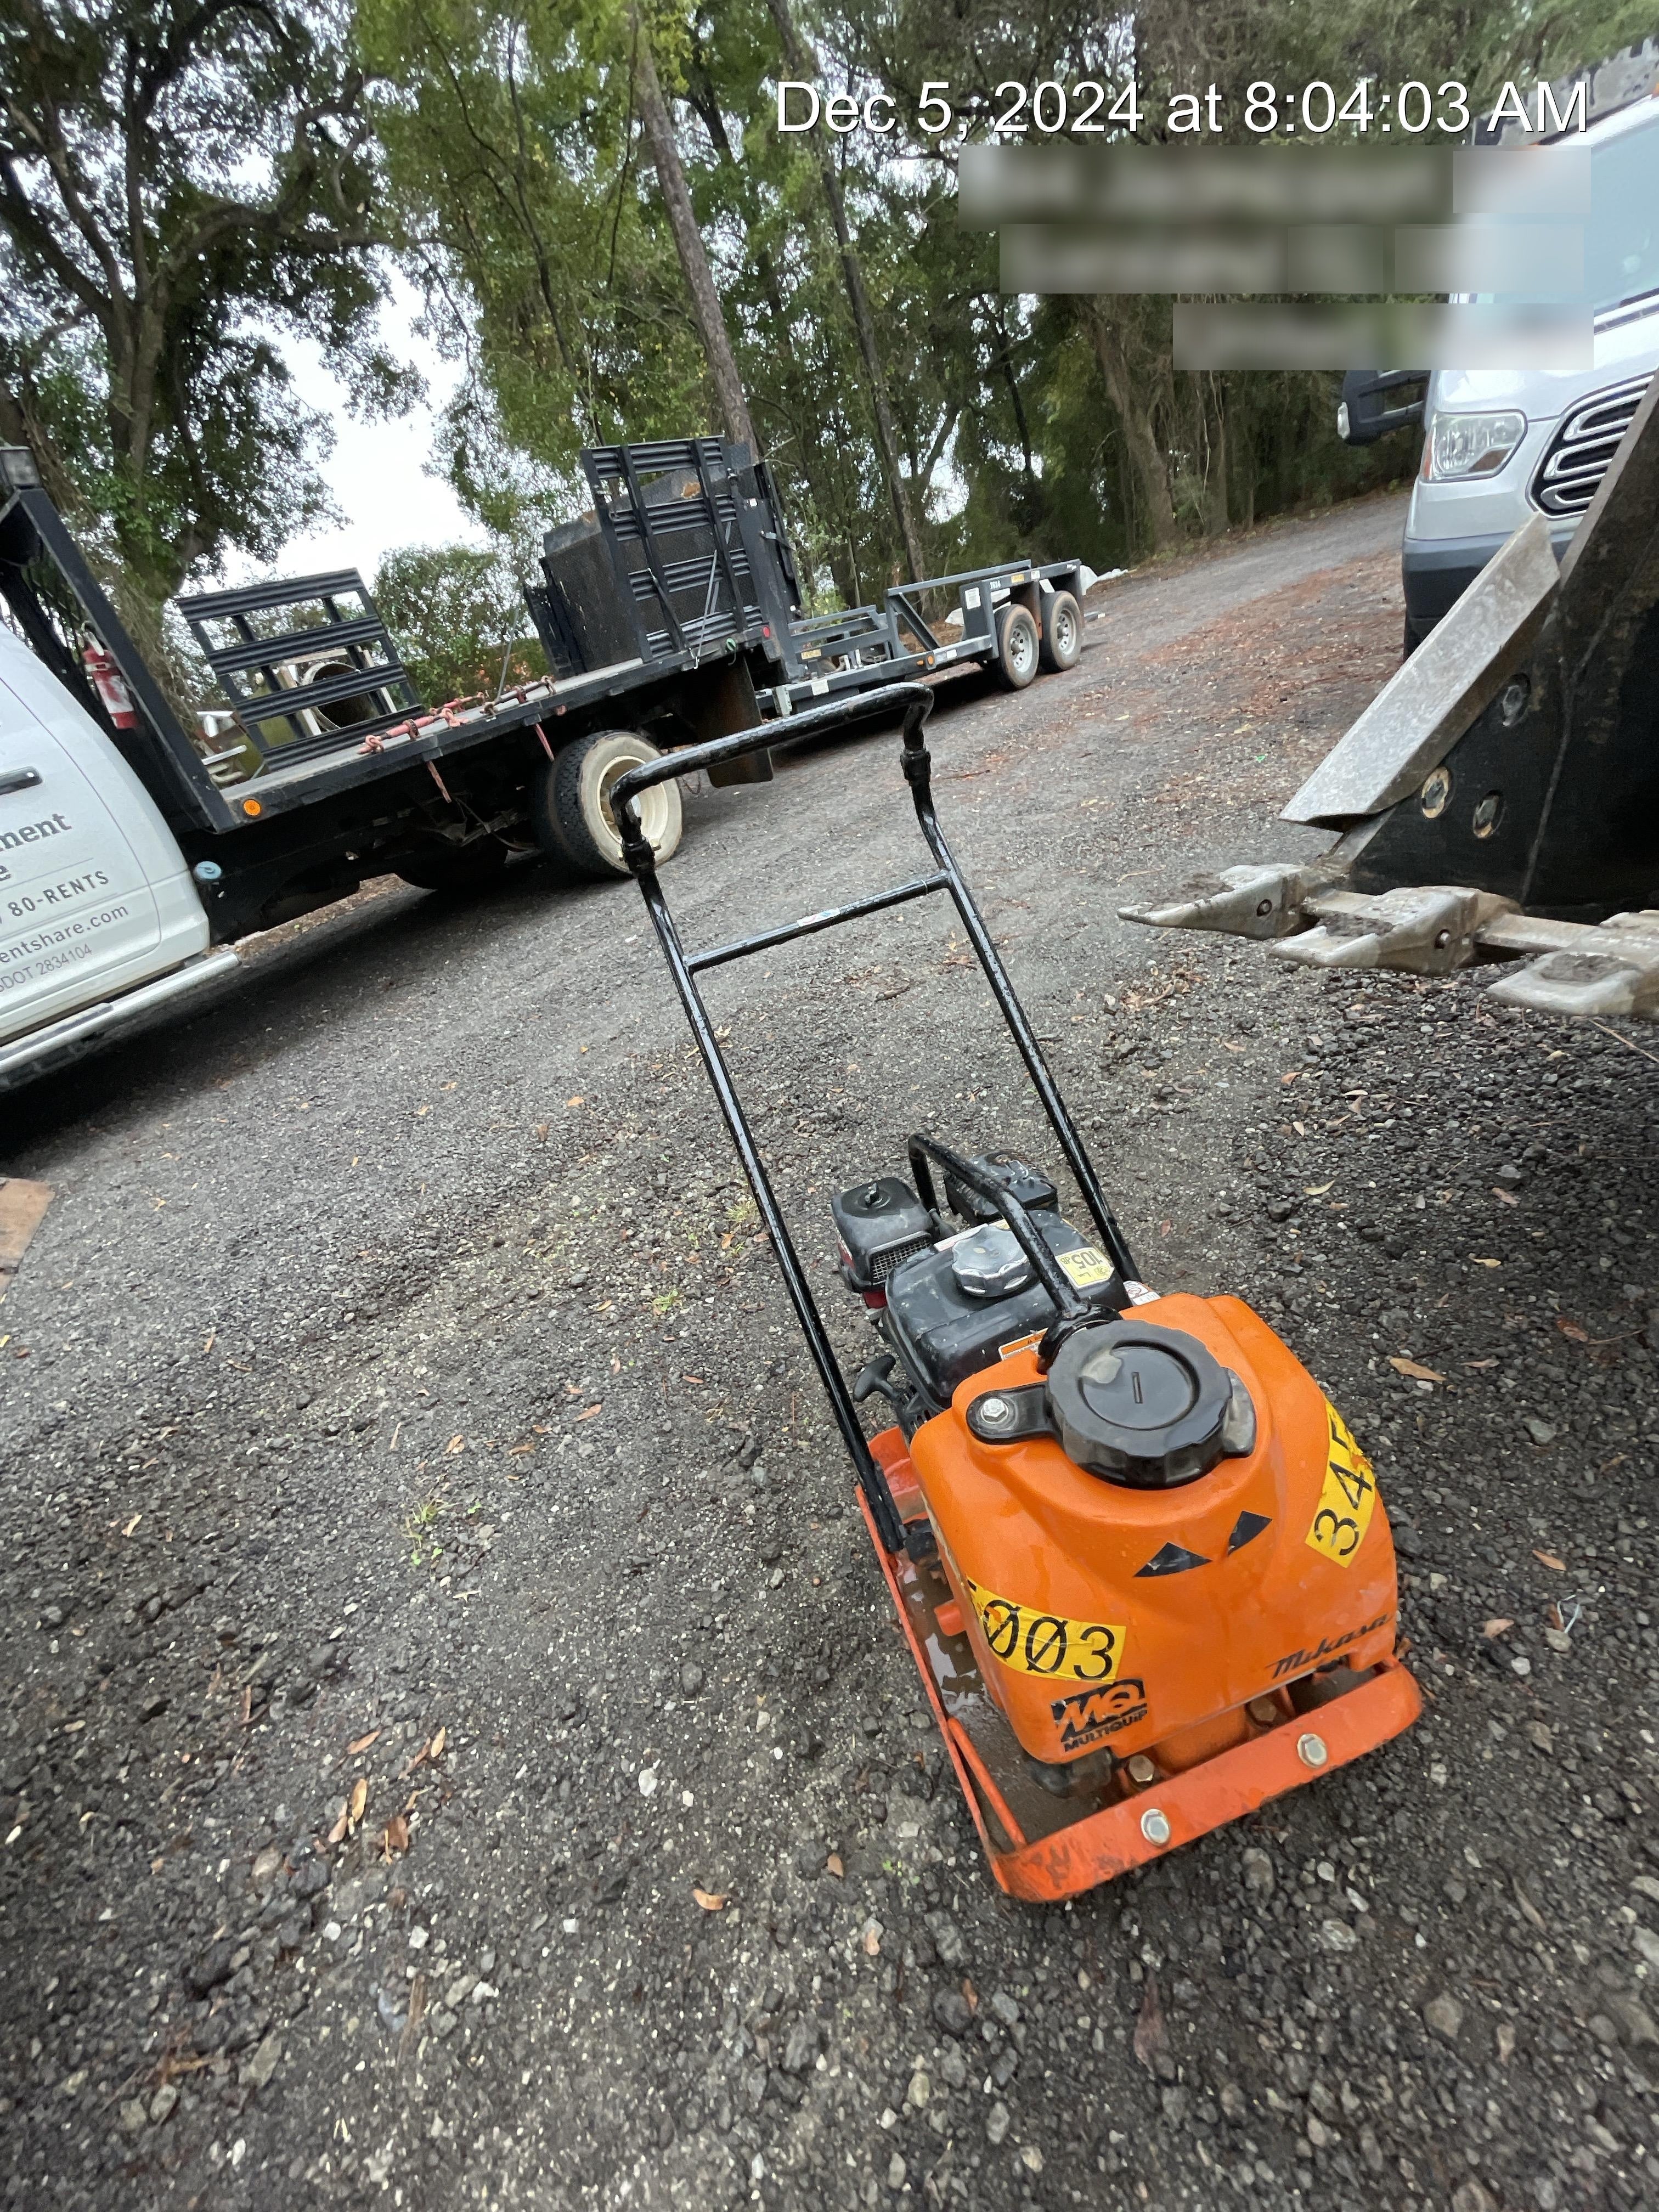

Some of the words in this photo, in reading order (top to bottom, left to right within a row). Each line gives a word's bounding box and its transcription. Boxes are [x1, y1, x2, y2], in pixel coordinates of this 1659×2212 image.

[8, 871, 109, 917] 80-RENTS
[0, 906, 128, 963] entshare.com
[1071, 1250, 1103, 1269] 105
